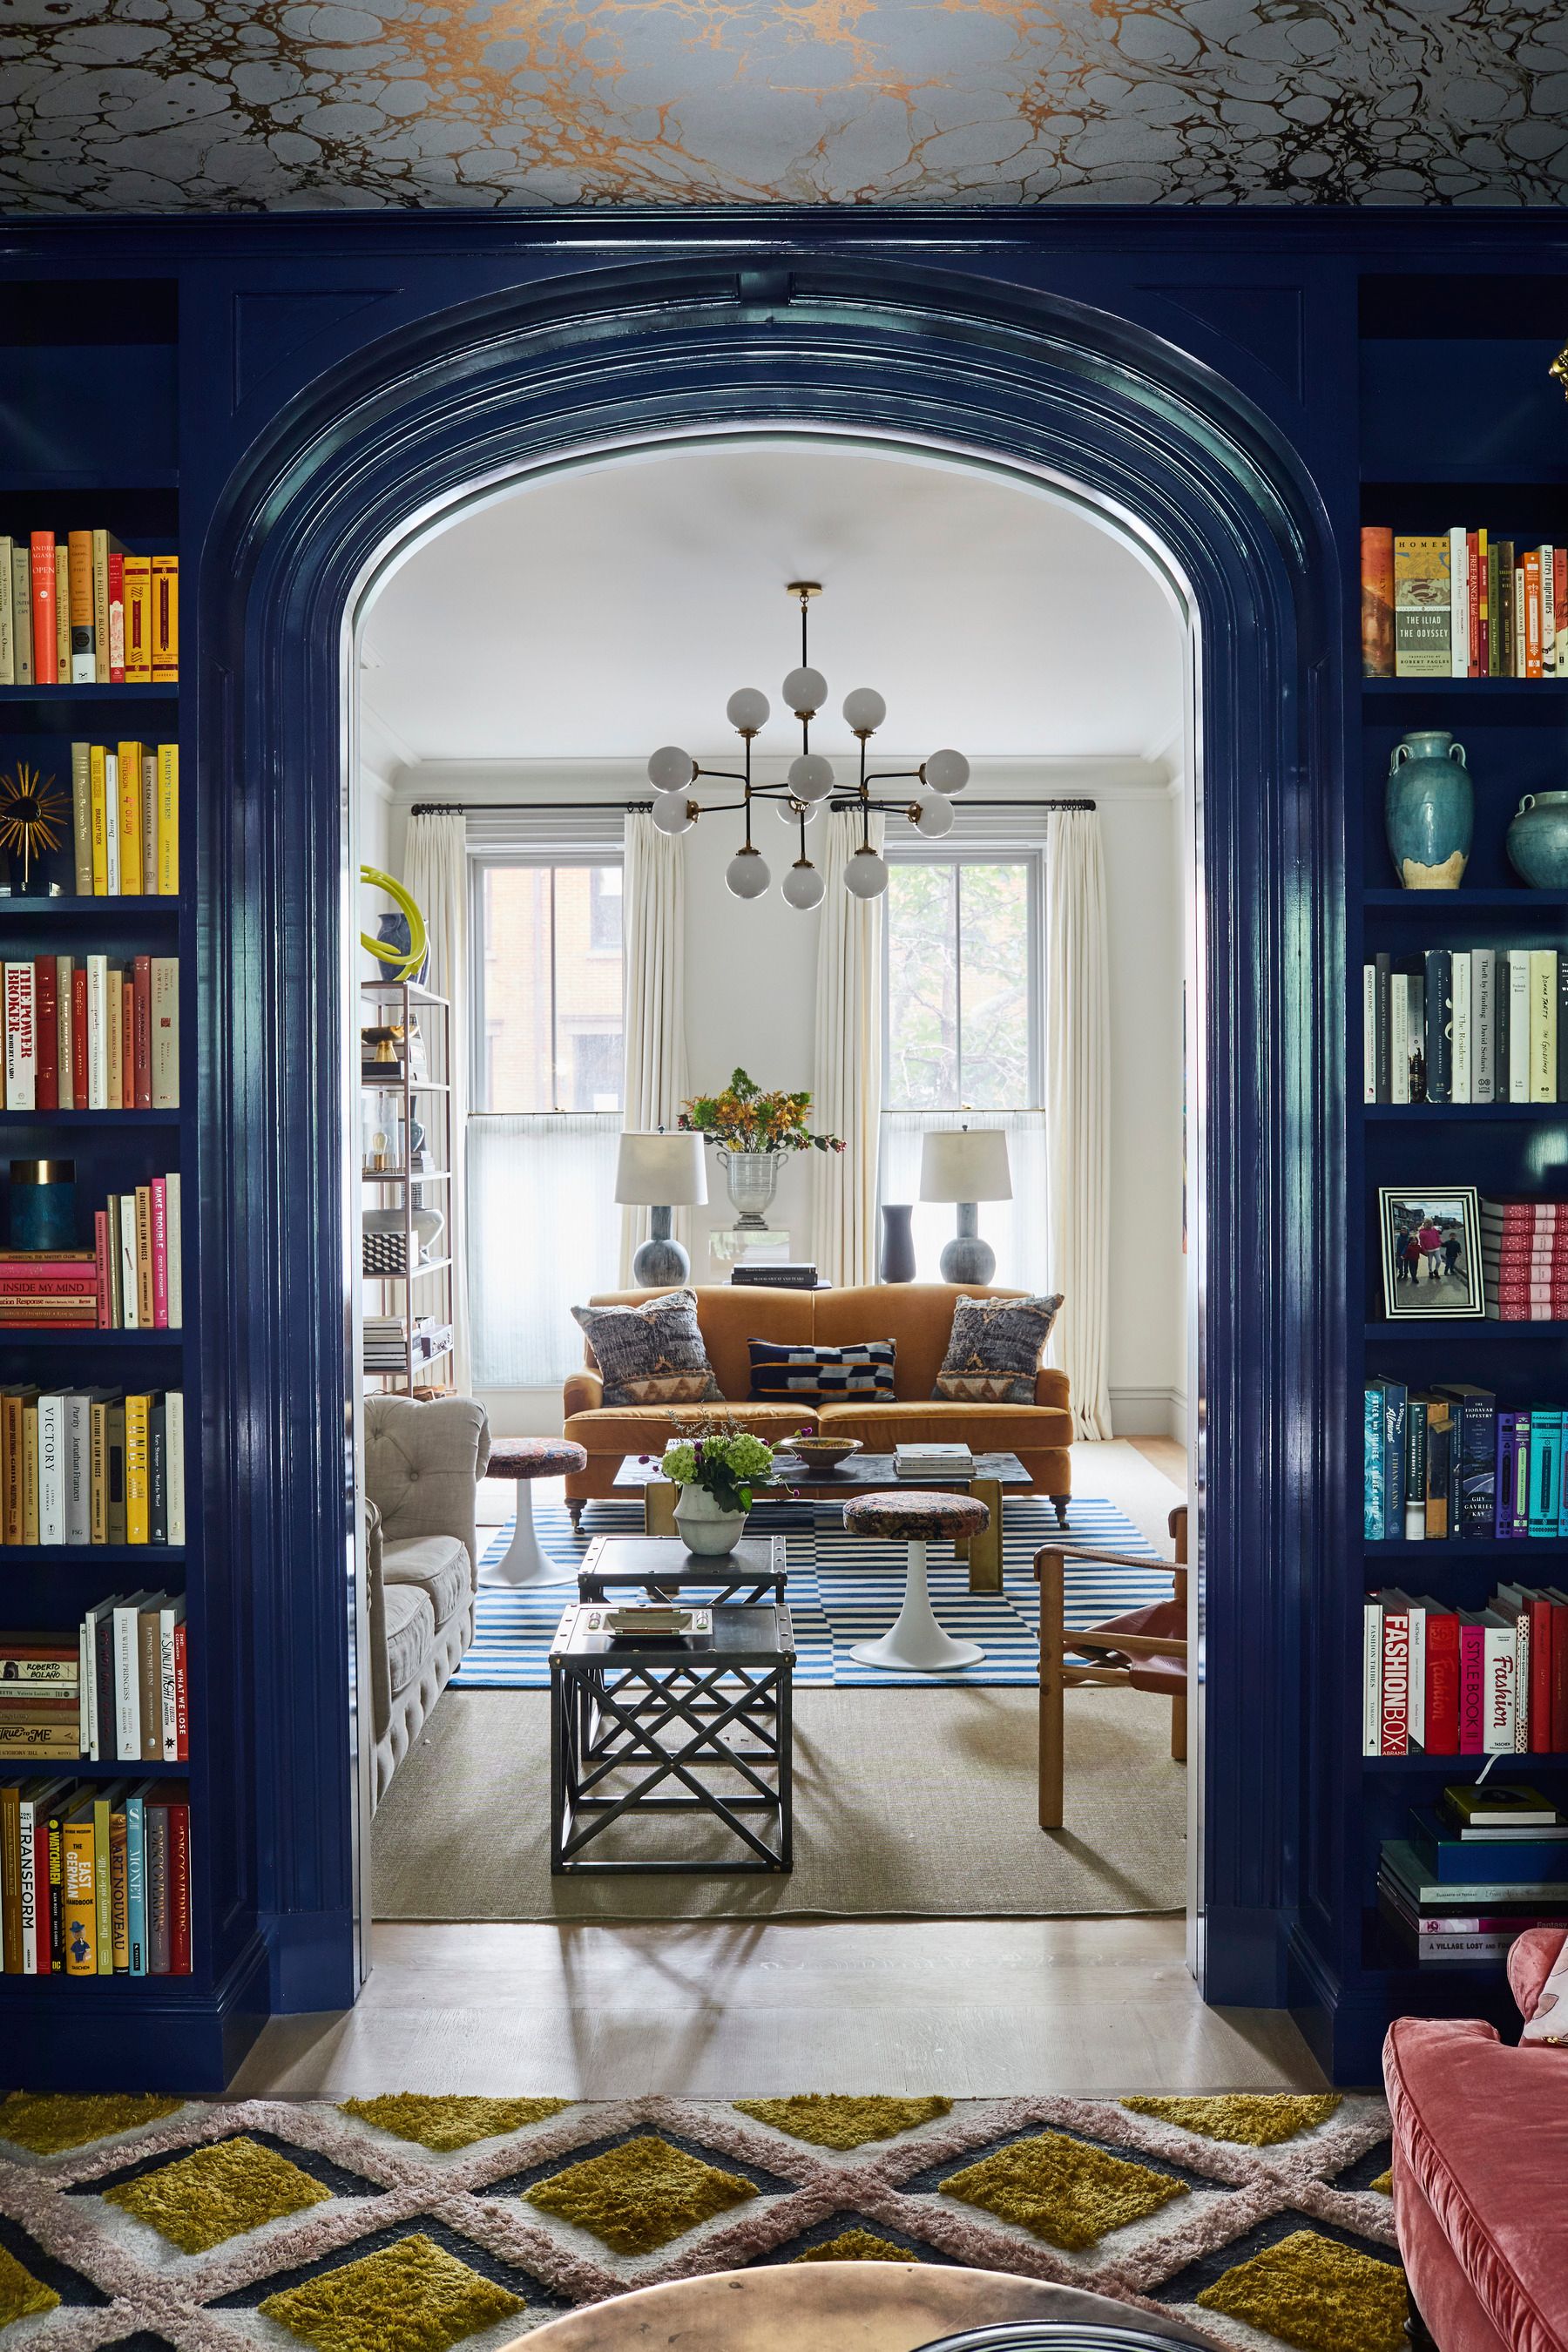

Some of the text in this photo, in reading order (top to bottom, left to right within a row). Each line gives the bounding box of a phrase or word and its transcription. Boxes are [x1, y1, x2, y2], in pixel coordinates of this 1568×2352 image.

[1544, 550, 1553, 614] Jeffrey Eugenides
[98, 605, 104, 616] OF
[1406, 616, 1442, 625] THE ILIAD
[1400, 629, 1449, 638] THE ODYSSEY
[7, 969, 20, 1033] BROKER
[1479, 990, 1489, 1018] Finding
[1480, 980, 1489, 990] by
[19, 966, 32, 1058] THE POWER
[1458, 1032, 1467, 1071] Residence
[1480, 1024, 1489, 1073] David Sedaris
[154, 1186, 164, 1248] MAKE TROUBLE
[3, 1283, 84, 1292] INSIDE MY MIND
[71, 1406, 81, 1429] Purity
[1385, 1405, 1396, 1443] Almanac
[1395, 1408, 1405, 1435] DOUBTER'S
[44, 1407, 55, 1472] VICTORY
[72, 1436, 81, 1502] Jonathan Franzen
[30, 1669, 61, 1679] BOLAÑO
[120, 1617, 131, 1701] THE WHITE PRINCESS
[161, 1639, 174, 1673] SUNLIT
[1465, 1640, 1480, 1680] STYLE
[162, 1673, 175, 1702] NIGHT
[1382, 1615, 1408, 1748] FASHIONBOX
[1429, 1657, 1456, 1721] Fashion
[1492, 1655, 1514, 1728] Fashion
[178, 1696, 185, 1710] WE
[1465, 1684, 1480, 1728] BOOK
[0, 1727, 25, 1740] TRUE
[27, 1729, 52, 1743] ME
[20, 1823, 34, 1930] TRANSFORM
[48, 1830, 61, 1885] WATCHMEN
[65, 1851, 79, 1899] GERMAN
[78, 1862, 91, 1889] EAST
[100, 1855, 109, 1868] life
[100, 1867, 109, 1878] of
[129, 1849, 141, 1903] MONET
[100, 1879, 109, 1897] side
[112, 1845, 125, 1950] ART NOUVEAU
[152, 1830, 165, 1933] DISCOVERERS
[173, 1830, 186, 1933] DISCOVERERS
[100, 1898, 109, 1923] sunny
